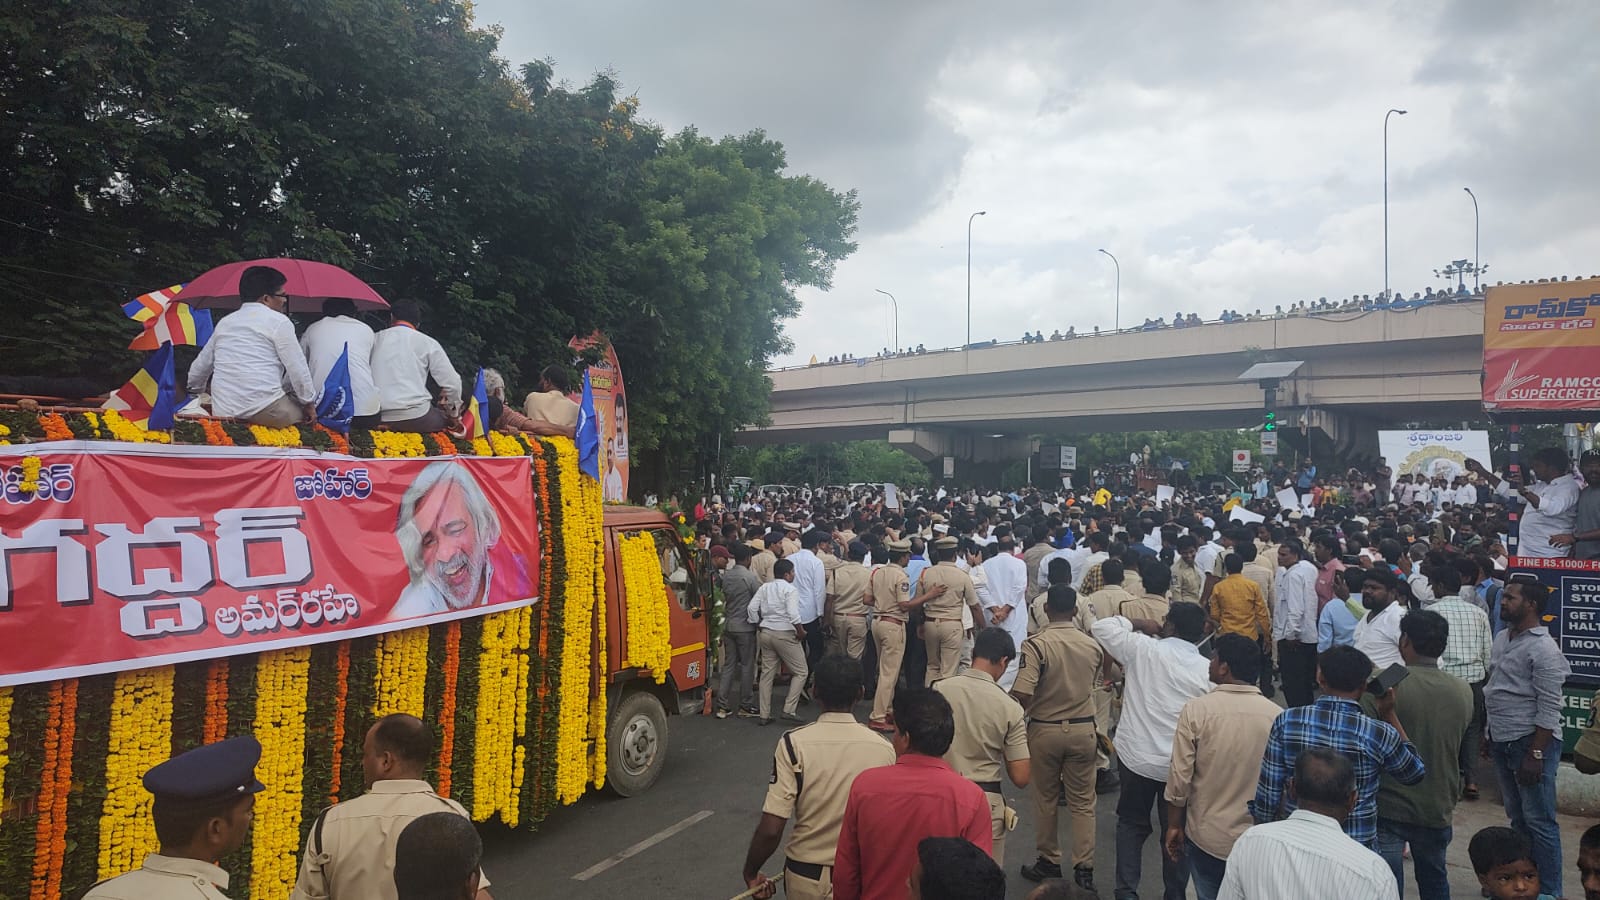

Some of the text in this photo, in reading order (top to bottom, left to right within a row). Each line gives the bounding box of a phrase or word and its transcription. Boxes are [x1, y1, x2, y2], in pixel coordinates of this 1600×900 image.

[1510, 388, 1600, 399] SUPERCRETE
[294, 467, 373, 501] జోహార్
[1518, 558, 1541, 567] FINE
[1570, 611, 1596, 620] GET
[1560, 695, 1593, 710] KEE
[1559, 715, 1587, 730] CLE
